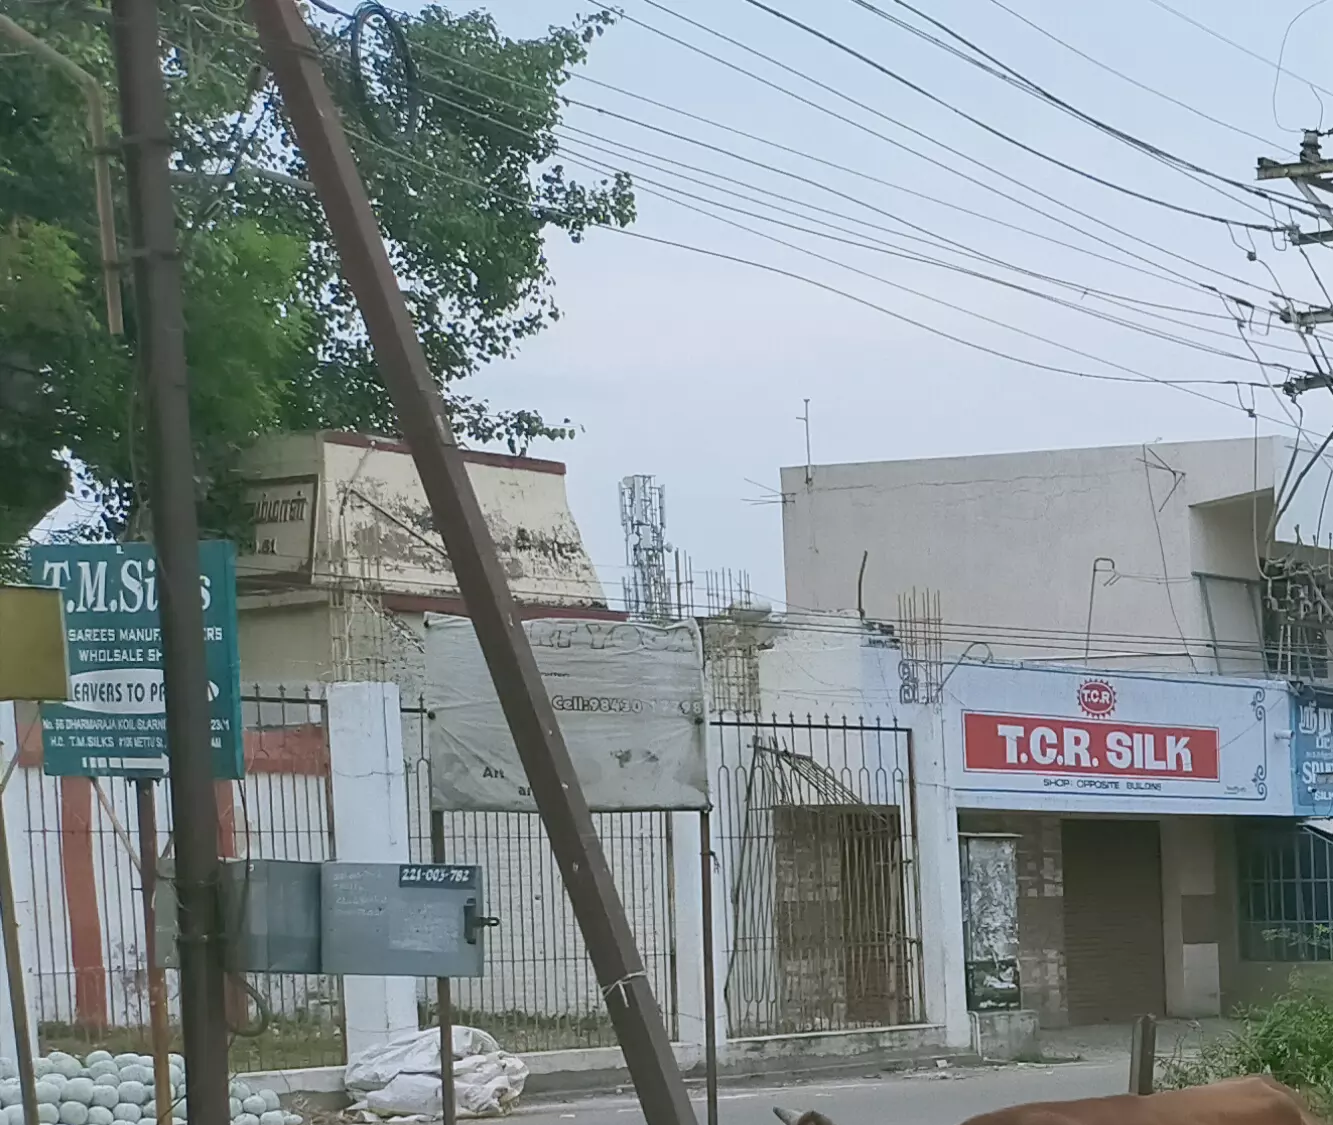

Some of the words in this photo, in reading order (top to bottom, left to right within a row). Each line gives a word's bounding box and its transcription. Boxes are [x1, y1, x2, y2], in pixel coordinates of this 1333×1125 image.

[42, 558, 211, 613] T.M.Sis
[68, 628, 115, 642] SAREES
[119, 627, 222, 642] MANUFRS
[530, 623, 578, 648] RT
[78, 649, 143, 662] WHOLSALE
[73, 683, 122, 702] EAVERS
[126, 683, 145, 701] TO
[997, 723, 1099, 768] T.C.R.
[1106, 731, 1192, 772] SILK
[1077, 780, 1120, 790] OPPOSITE
